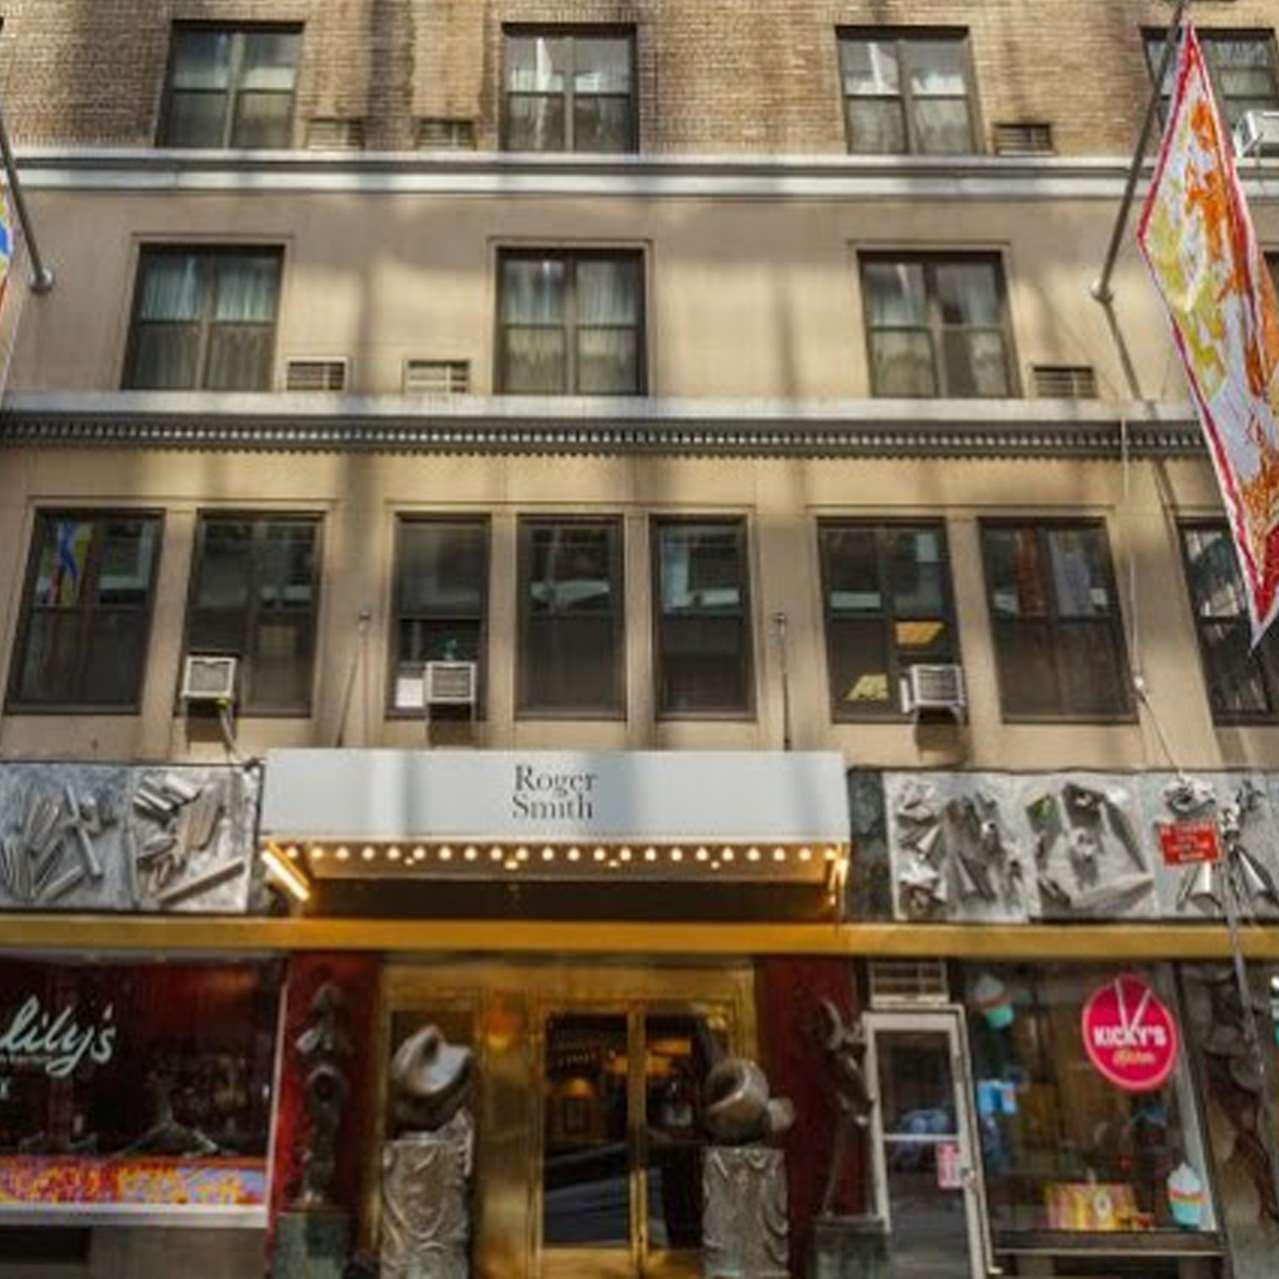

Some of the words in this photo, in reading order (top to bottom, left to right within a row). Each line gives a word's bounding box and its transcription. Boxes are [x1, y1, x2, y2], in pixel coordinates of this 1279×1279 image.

[514, 764, 599, 798] Roger
[511, 793, 594, 820] Smith
[1093, 1023, 1168, 1048] KICKY'S
